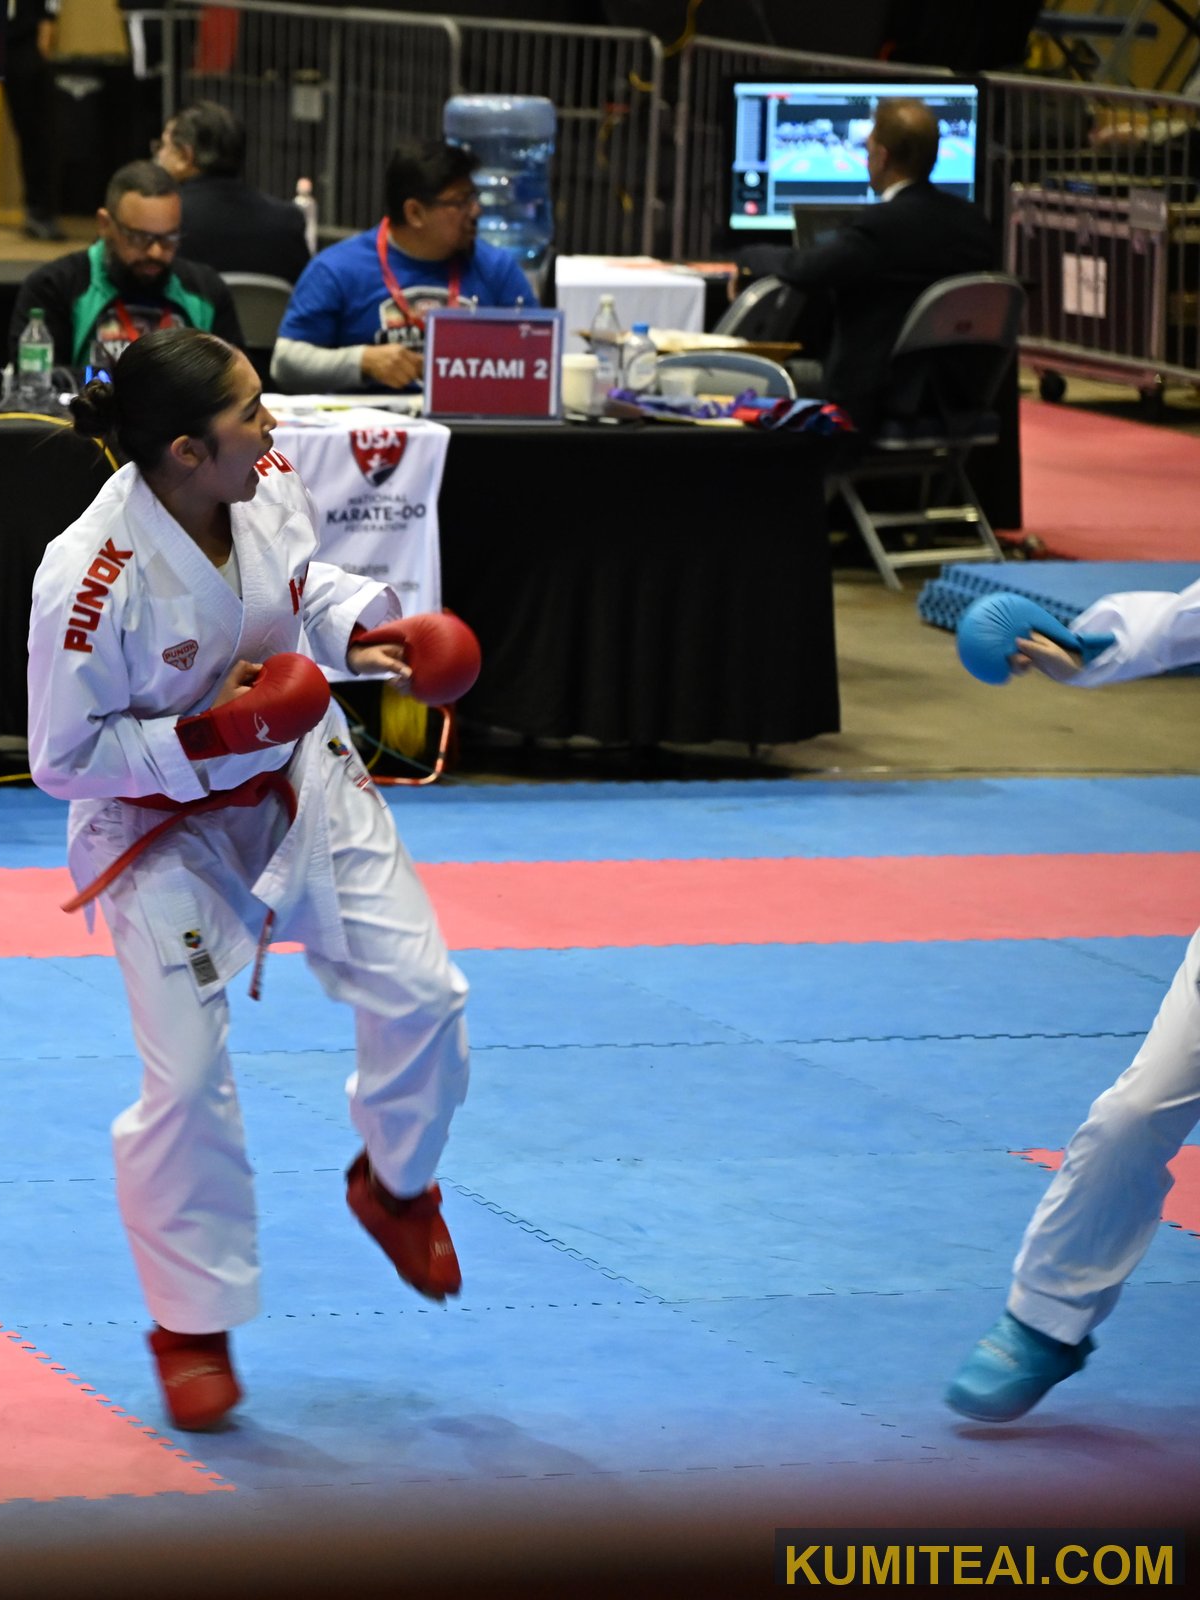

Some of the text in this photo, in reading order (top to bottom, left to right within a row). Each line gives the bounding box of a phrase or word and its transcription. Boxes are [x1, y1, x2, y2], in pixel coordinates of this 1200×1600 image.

[435, 357, 548, 379] TATAMI 2
[356, 428, 401, 449] USA
[326, 503, 427, 525] KARATE-DO
[63, 537, 134, 654] PUNOK
[164, 642, 196, 661] PUNOK
